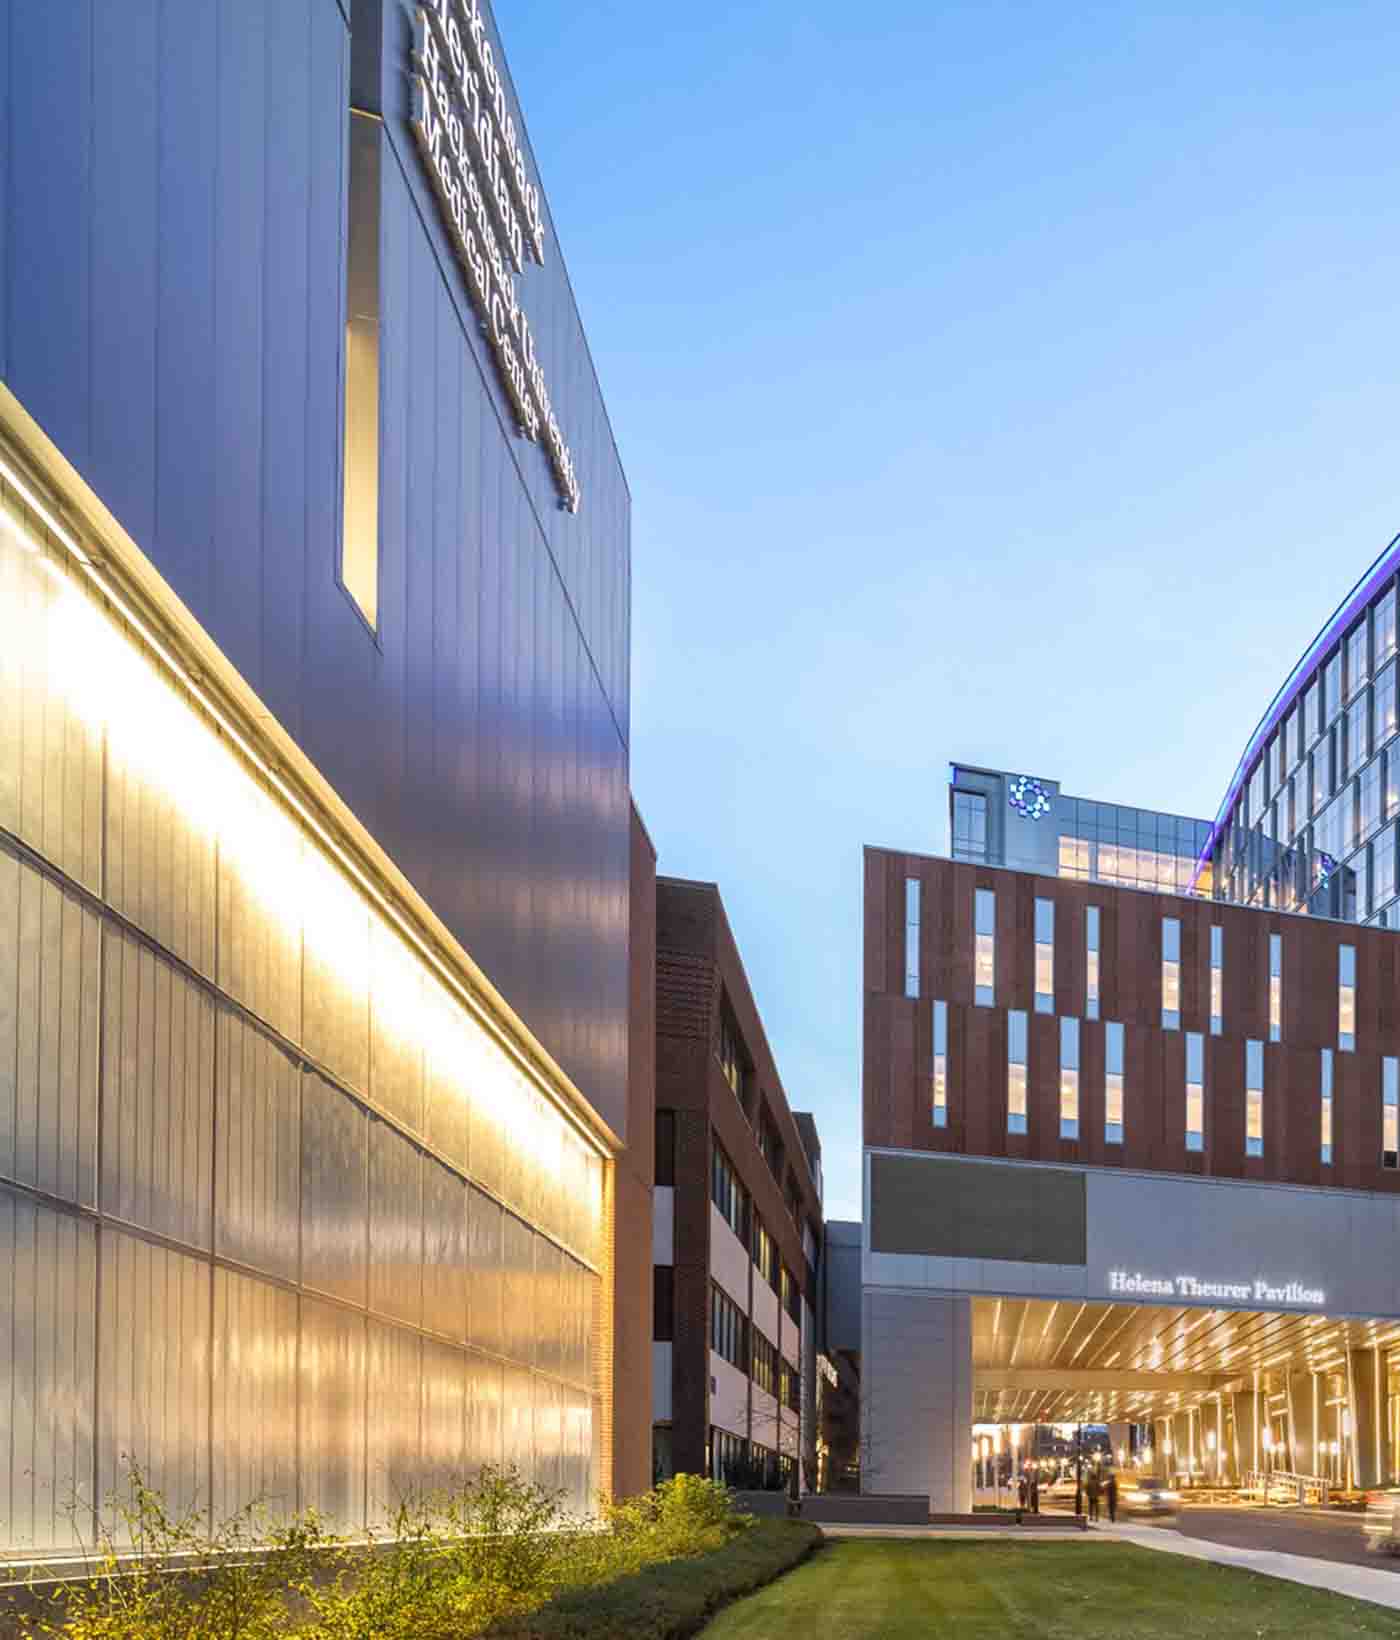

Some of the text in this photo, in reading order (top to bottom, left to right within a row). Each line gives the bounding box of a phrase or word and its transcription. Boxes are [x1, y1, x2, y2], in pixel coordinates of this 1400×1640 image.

[420, 77, 538, 442] Medical Center
[421, 9, 520, 338] Hackensack
[1109, 1271, 1325, 1304] Helena Theurer Pavilion
